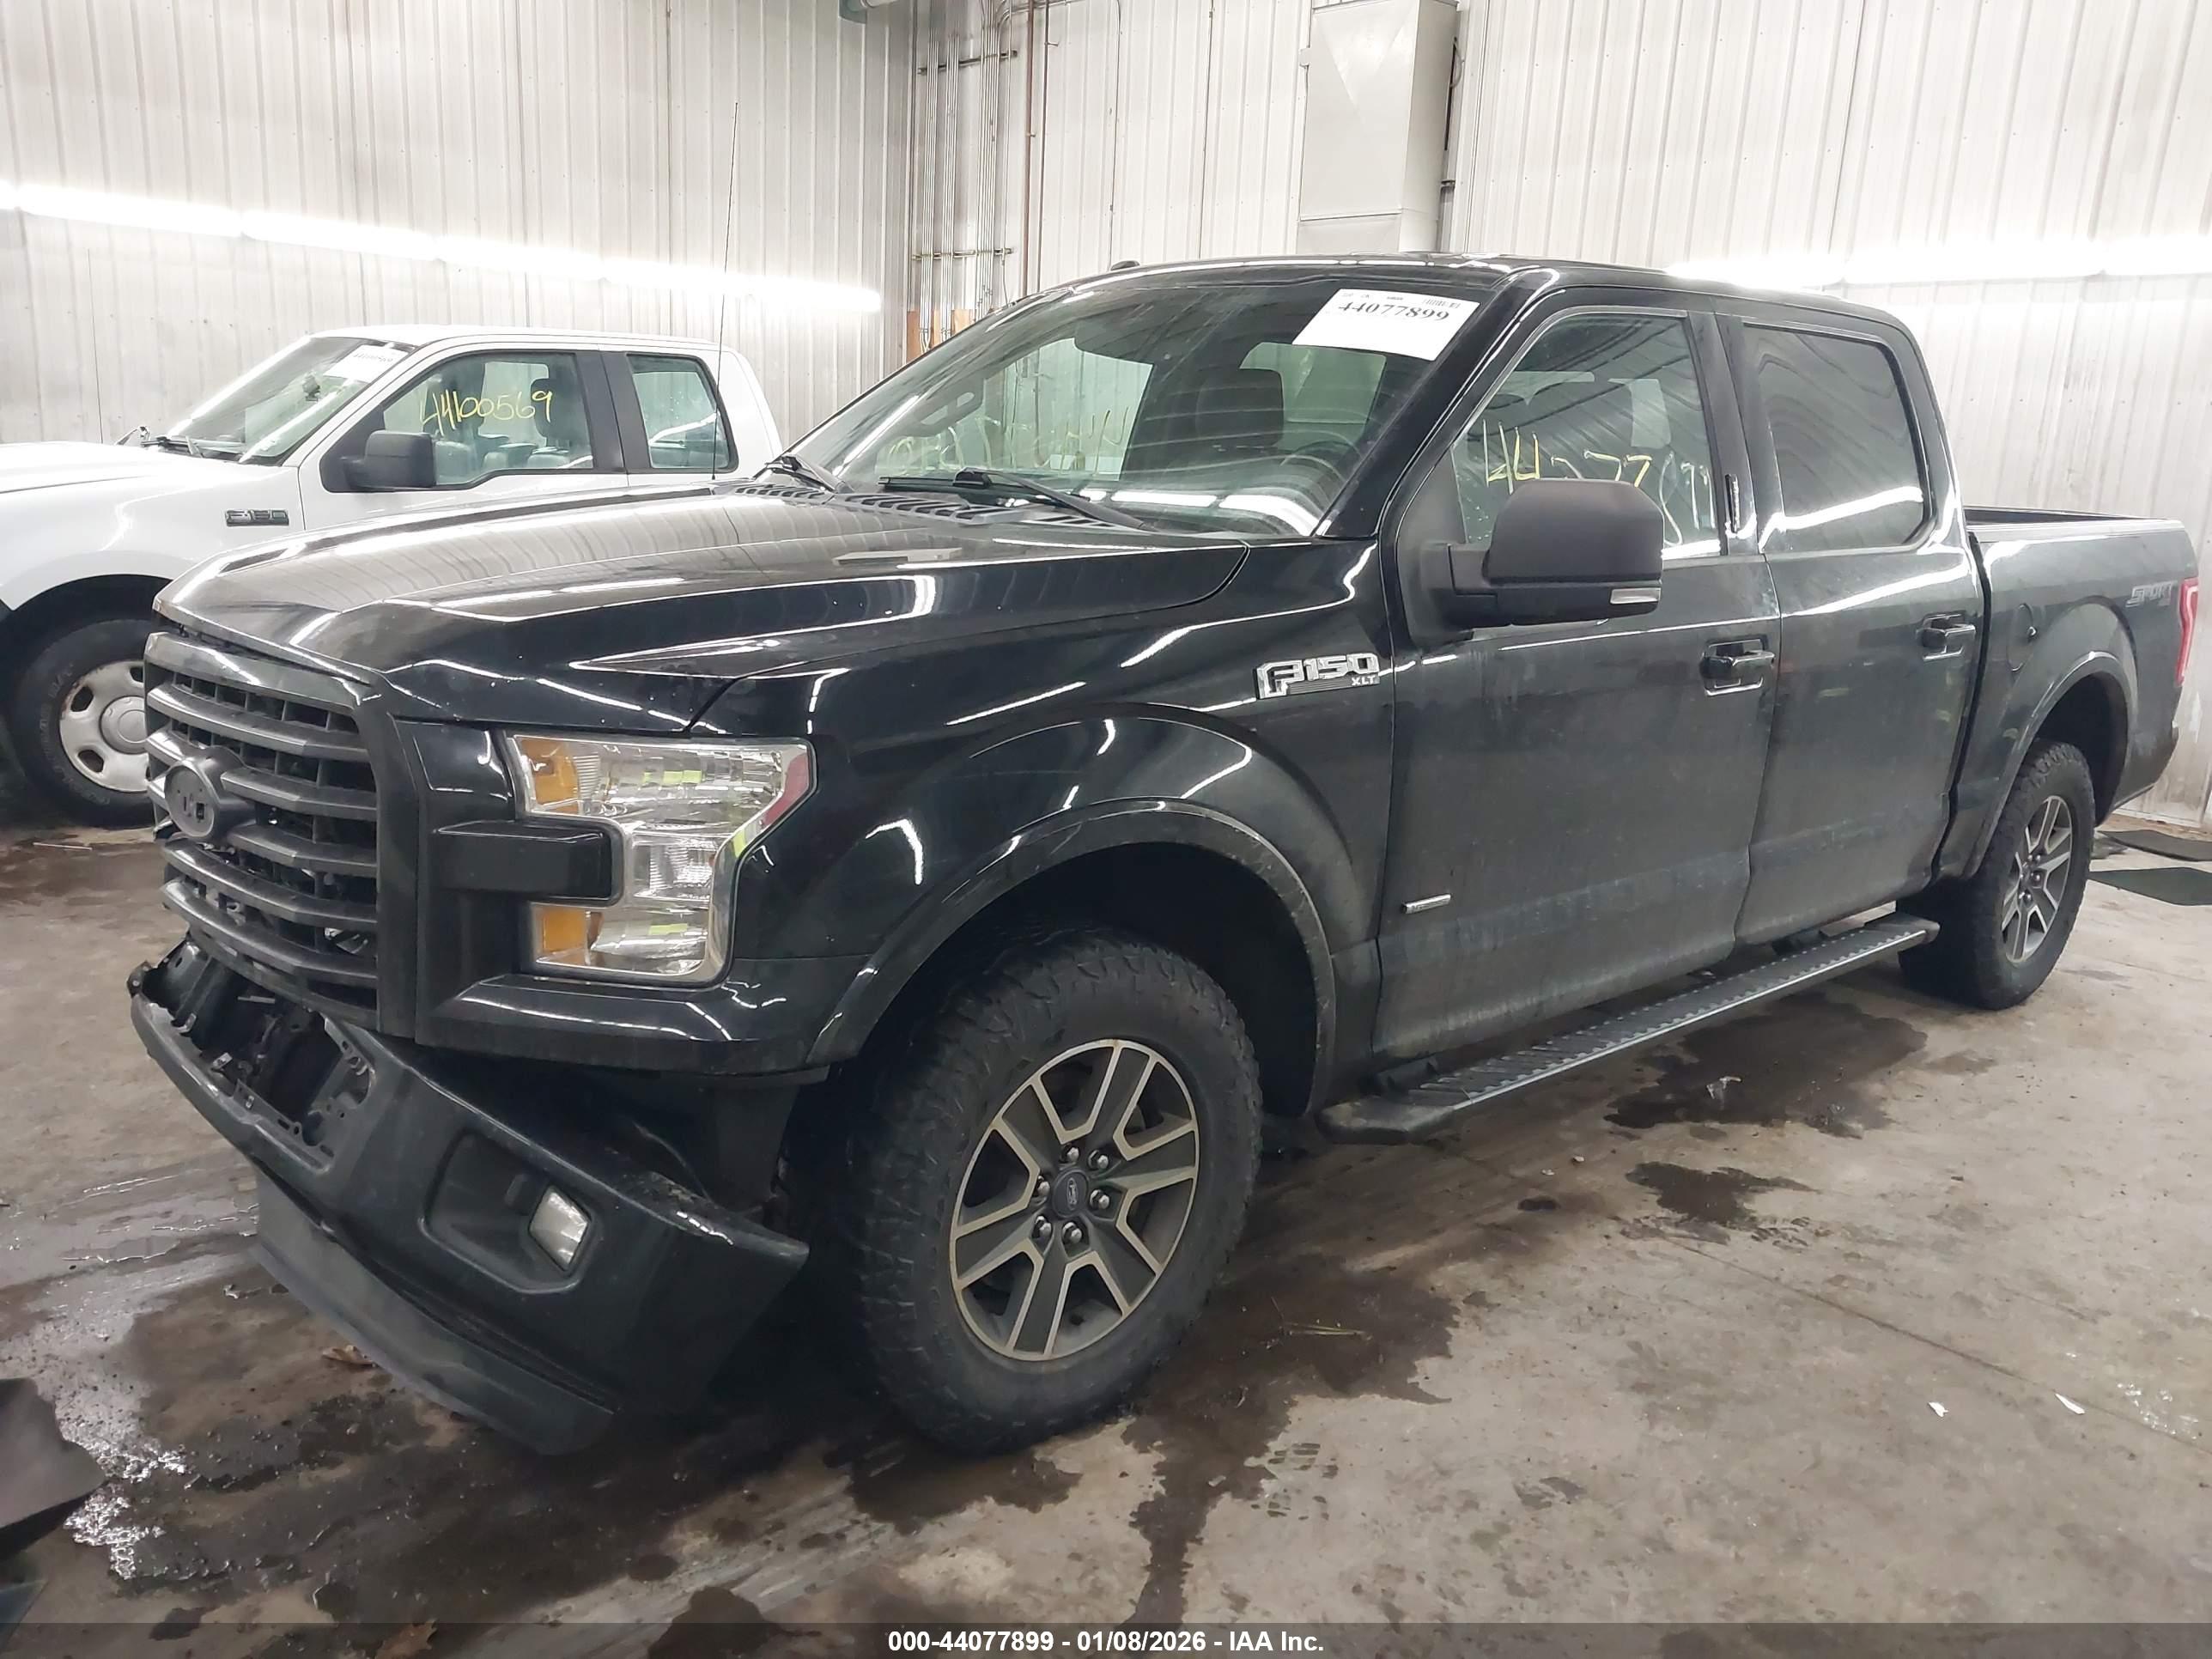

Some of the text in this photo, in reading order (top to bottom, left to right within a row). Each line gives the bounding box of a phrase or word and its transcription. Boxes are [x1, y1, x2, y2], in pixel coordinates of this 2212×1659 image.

[1338, 301, 1449, 321] 44077899
[419, 389, 553, 436] 44100569
[1352, 675, 1376, 686] XLT
